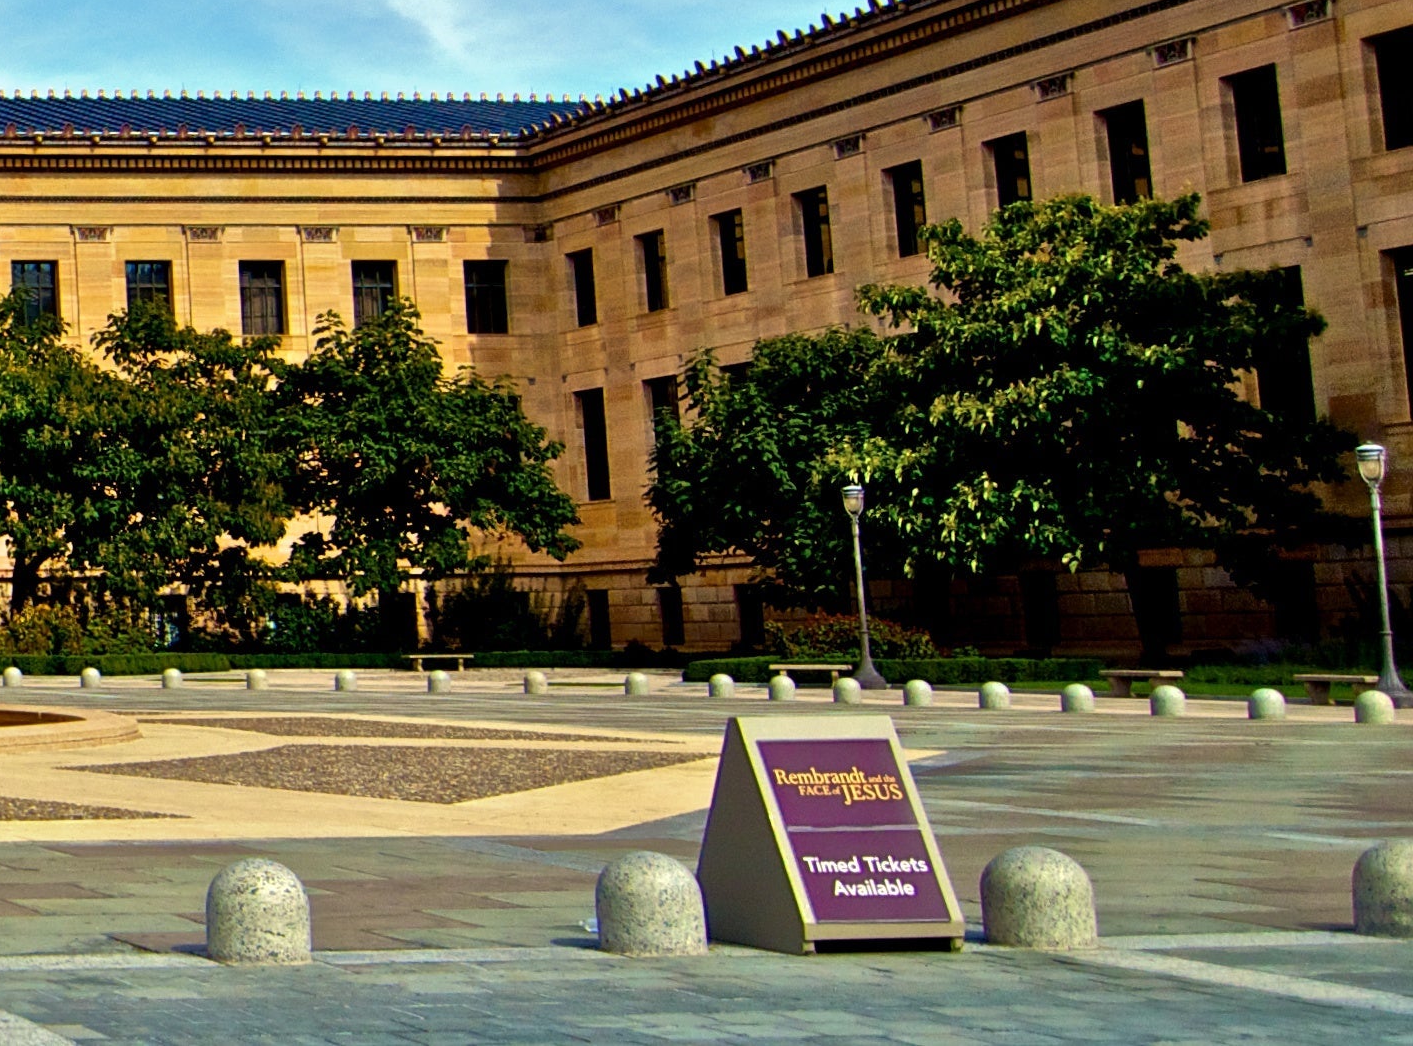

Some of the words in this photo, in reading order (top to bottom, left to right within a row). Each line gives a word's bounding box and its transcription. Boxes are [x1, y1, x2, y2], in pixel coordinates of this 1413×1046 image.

[773, 767, 867, 785] Rembrandt
[868, 775, 882, 783] and
[883, 774, 896, 783] the
[798, 785, 832, 796] FACE
[832, 786, 841, 795] of
[841, 785, 903, 805] JESUS
[803, 856, 861, 873] Timed
[863, 856, 928, 873] Tickets
[834, 879, 915, 896] Available
